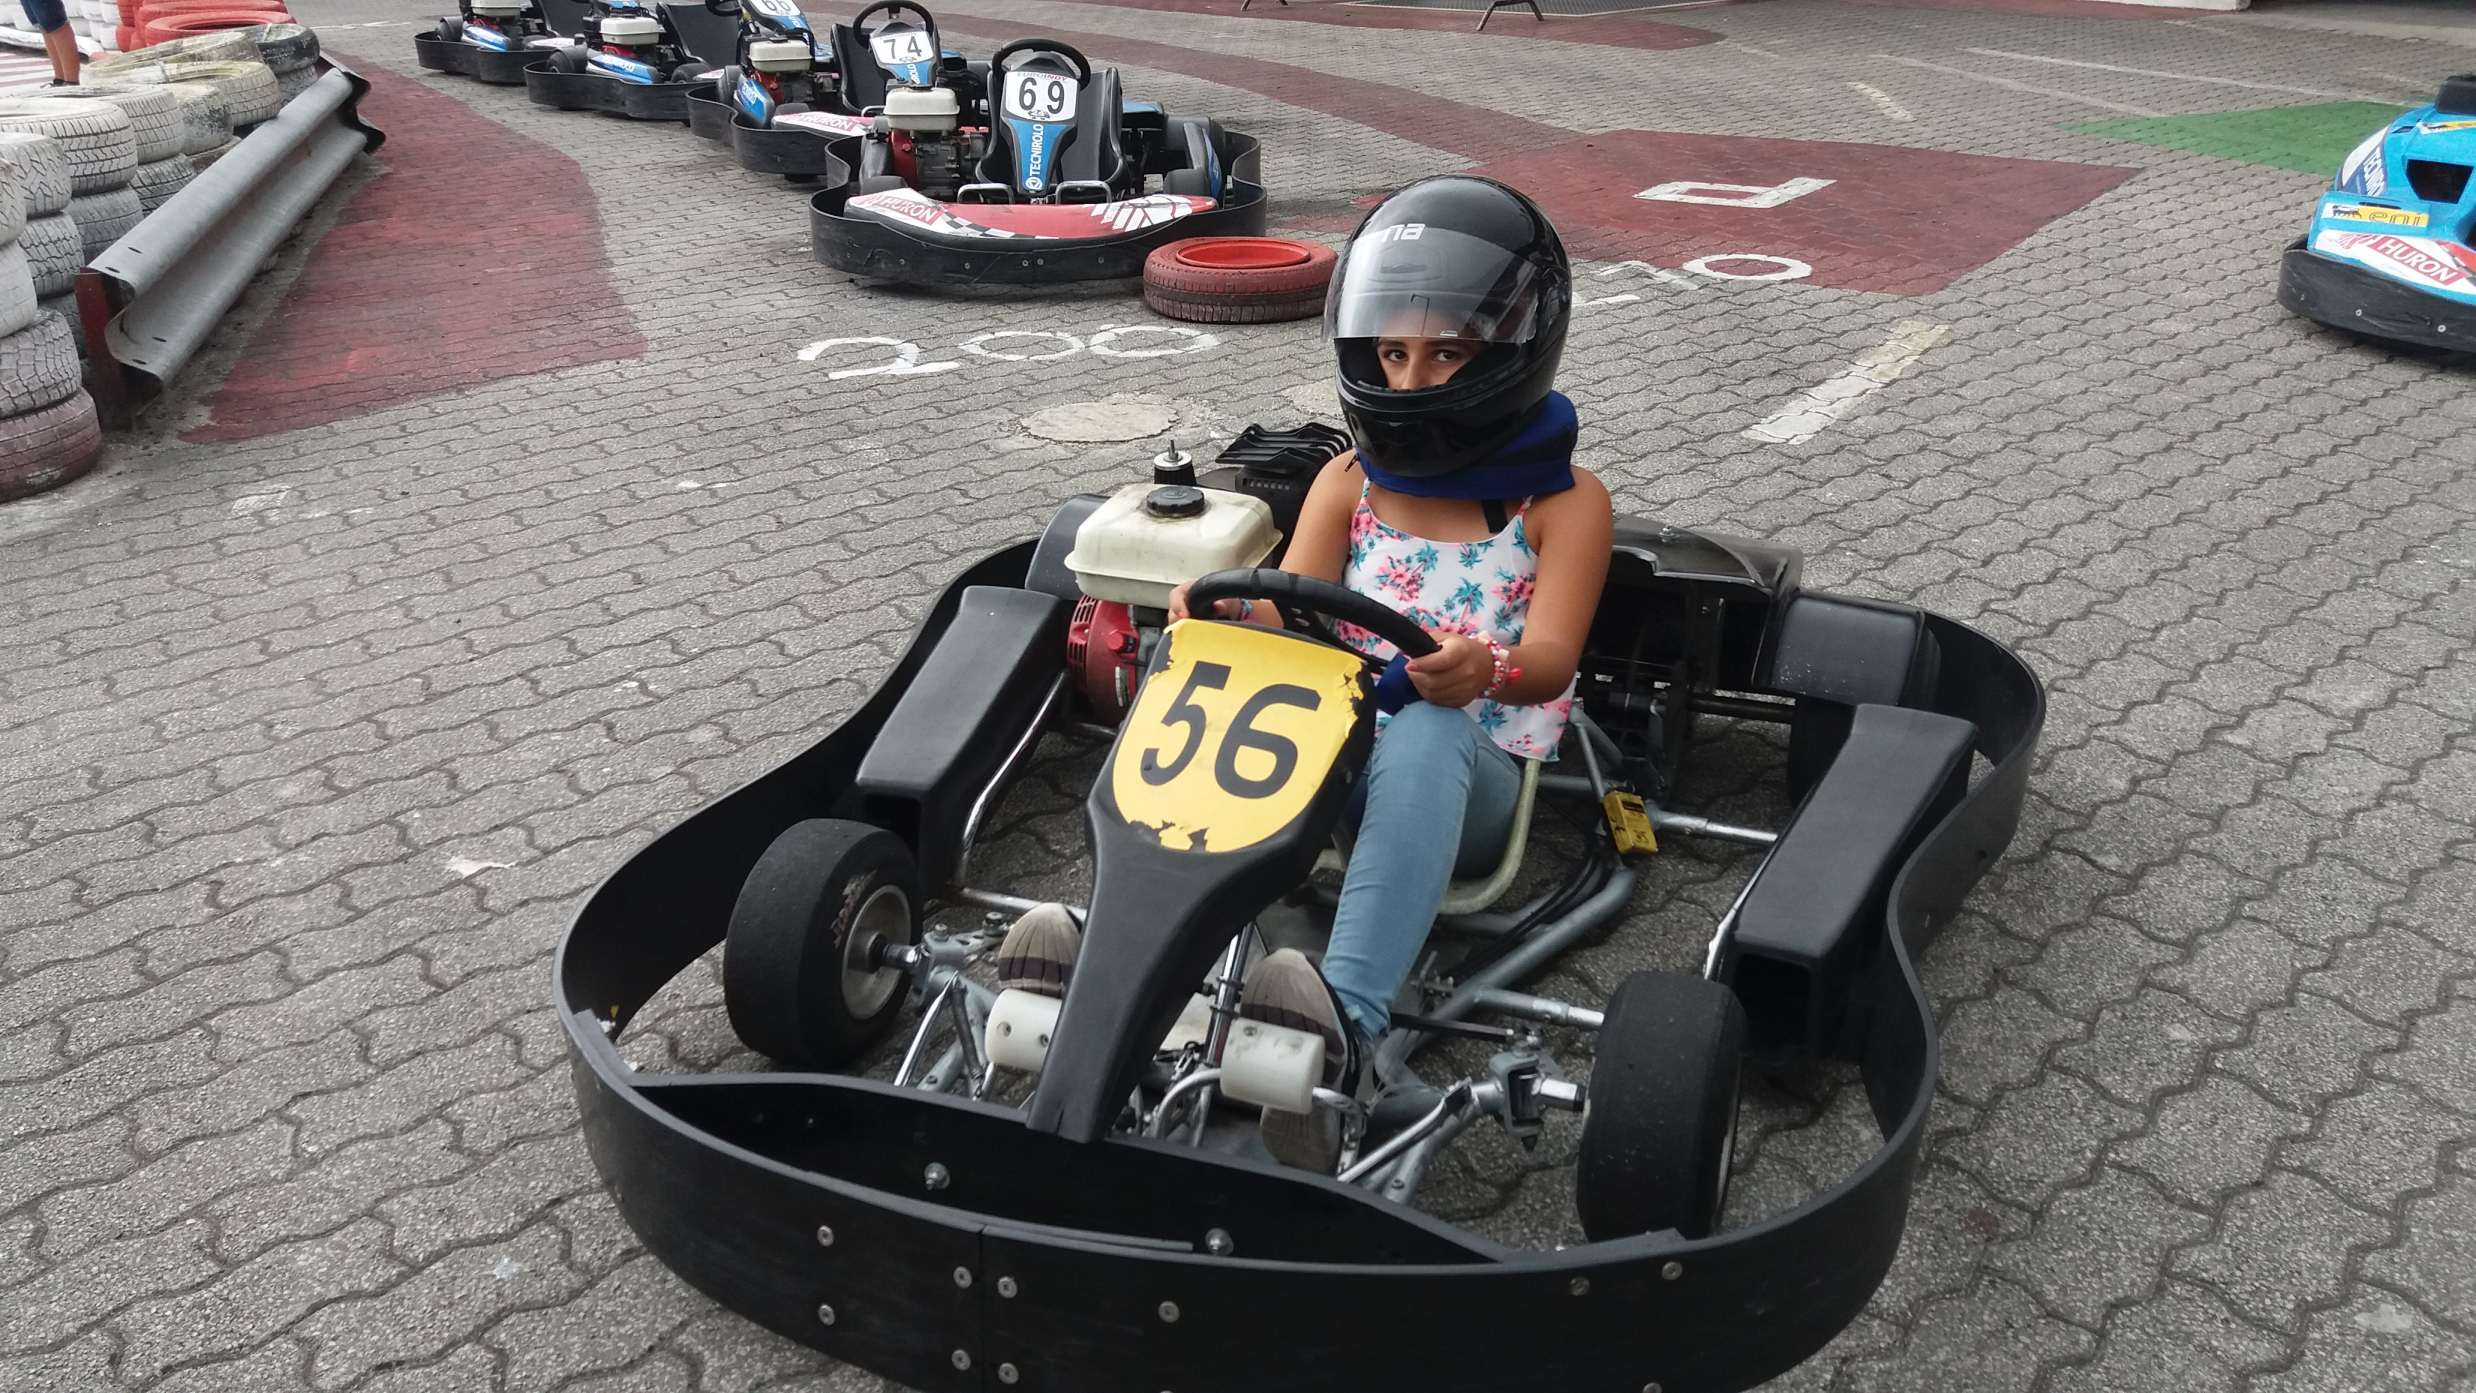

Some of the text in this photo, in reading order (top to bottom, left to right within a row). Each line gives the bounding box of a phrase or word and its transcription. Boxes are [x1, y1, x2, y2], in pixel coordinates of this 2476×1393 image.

[883, 36, 922, 59] 74
[1019, 77, 1064, 114] 69
[1029, 123, 1044, 176] TECNIROLO
[881, 197, 939, 220] HURON
[2377, 238, 2457, 282] HURON
[1140, 661, 1322, 799] 56
